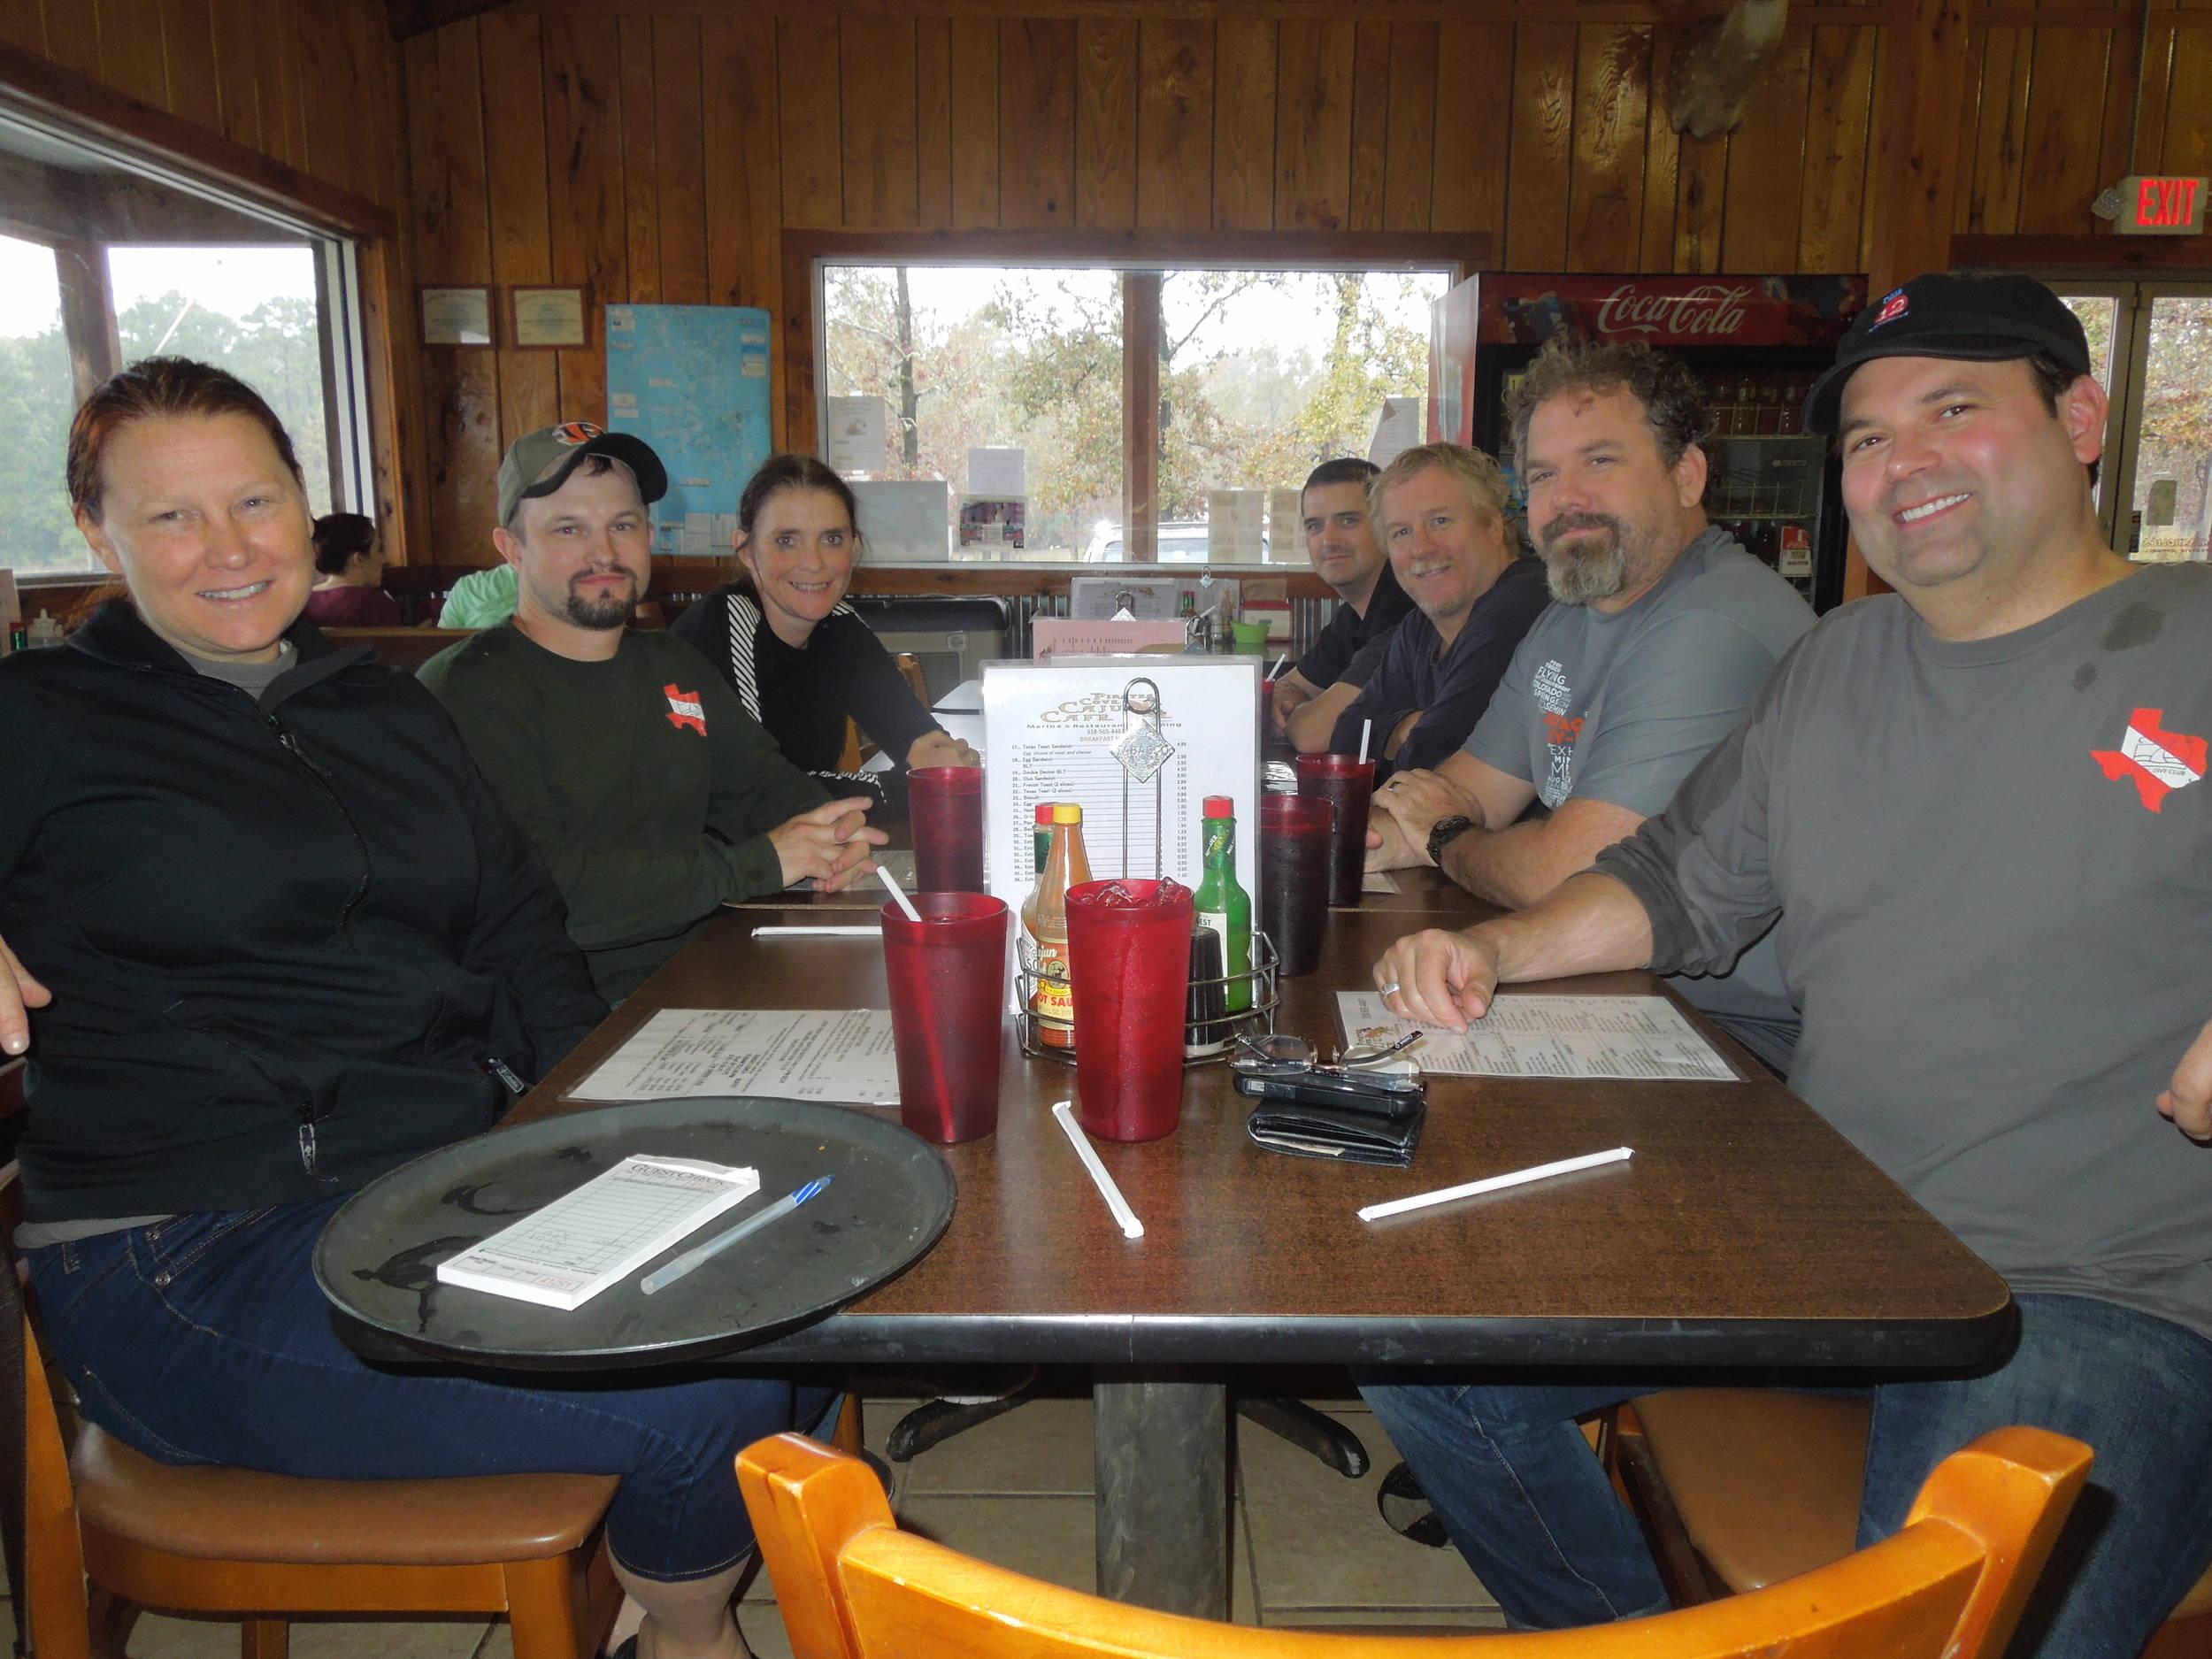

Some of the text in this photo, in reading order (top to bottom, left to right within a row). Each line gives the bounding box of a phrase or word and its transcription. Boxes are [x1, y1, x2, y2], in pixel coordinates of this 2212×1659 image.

[2136, 178, 2200, 227] EXIT
[1058, 702, 1123, 714] CAJU
[1050, 996, 1073, 1007] SAU
